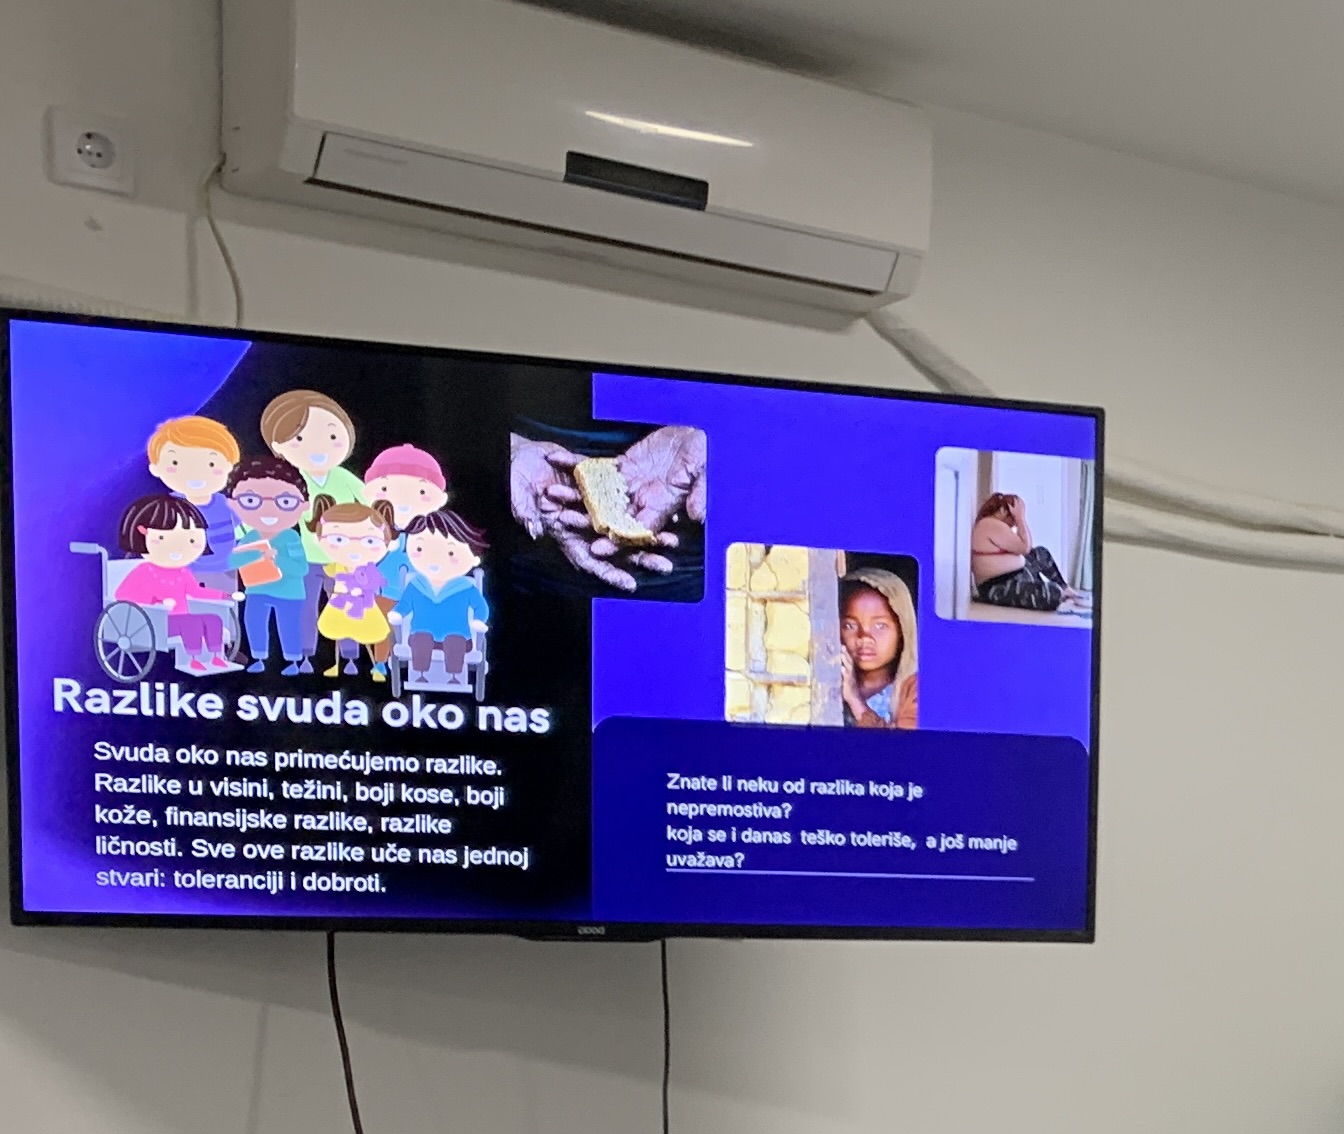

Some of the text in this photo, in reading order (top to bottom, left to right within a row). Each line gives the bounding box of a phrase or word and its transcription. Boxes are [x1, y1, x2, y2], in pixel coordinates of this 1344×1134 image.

[53, 678, 551, 734] Razlike svuda oko nas
[94, 742, 502, 776] Svuda oko nas primećujemo razlike.
[94, 773, 505, 810] Razlike u visini, težini, boji kose, boji
[666, 773, 924, 802] Znate li neku od razlika koja je
[95, 804, 452, 834] kože, finansijske razlike, razlike
[666, 802, 793, 819] nepremostiva?
[96, 836, 529, 870] ličnosti. Sve ove razlike uče nas jednoj
[666, 825, 1018, 855] koja se i danas teško toleriše, a još manje
[666, 851, 745, 868] uvažava?
[96, 868, 387, 895] stvari: toleranciji i dobroti.
